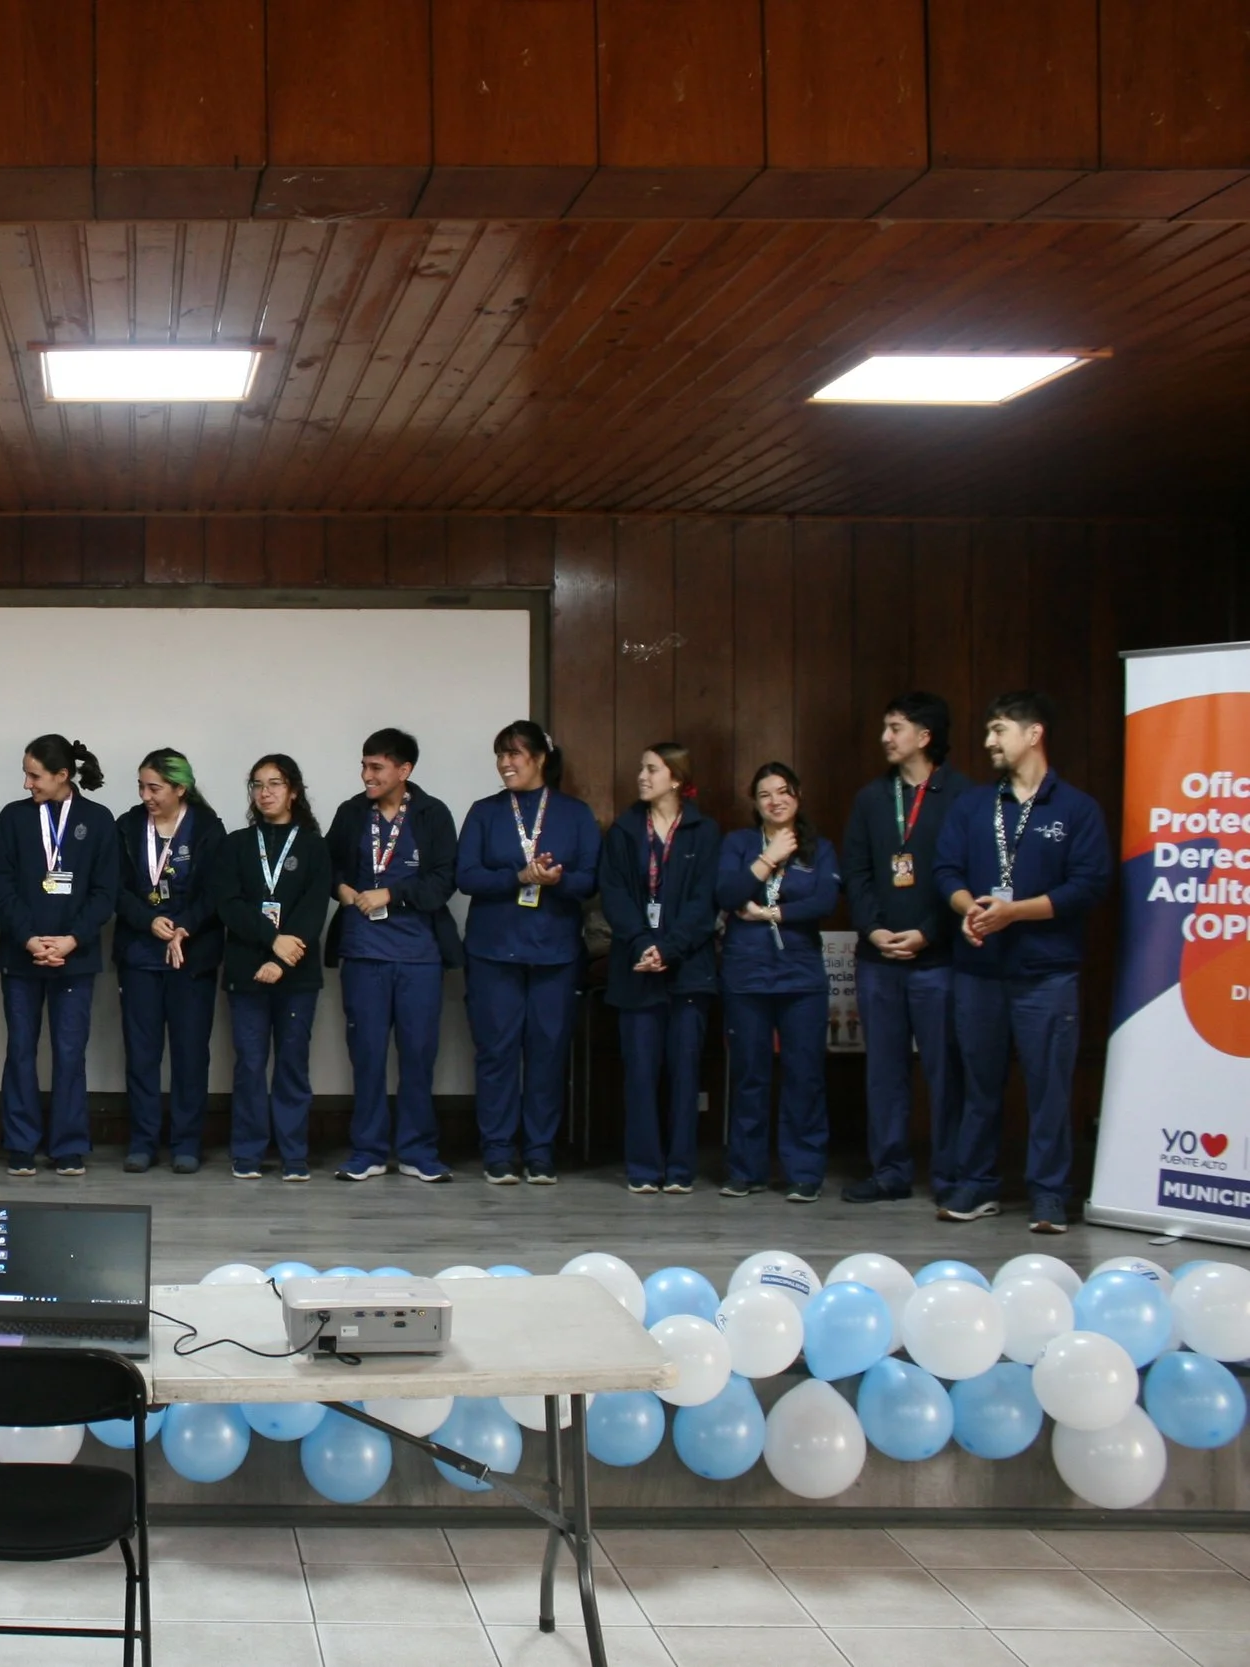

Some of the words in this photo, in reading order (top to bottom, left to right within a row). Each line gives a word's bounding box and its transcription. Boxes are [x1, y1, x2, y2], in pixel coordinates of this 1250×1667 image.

[1181, 771, 1250, 799] Ofic
[1154, 842, 1250, 870] Derec
[1181, 913, 1250, 942] (OP
[1161, 1128, 1197, 1155] YO
[1160, 1154, 1199, 1168] PUENTE
[1200, 1160, 1227, 1171] ALTO
